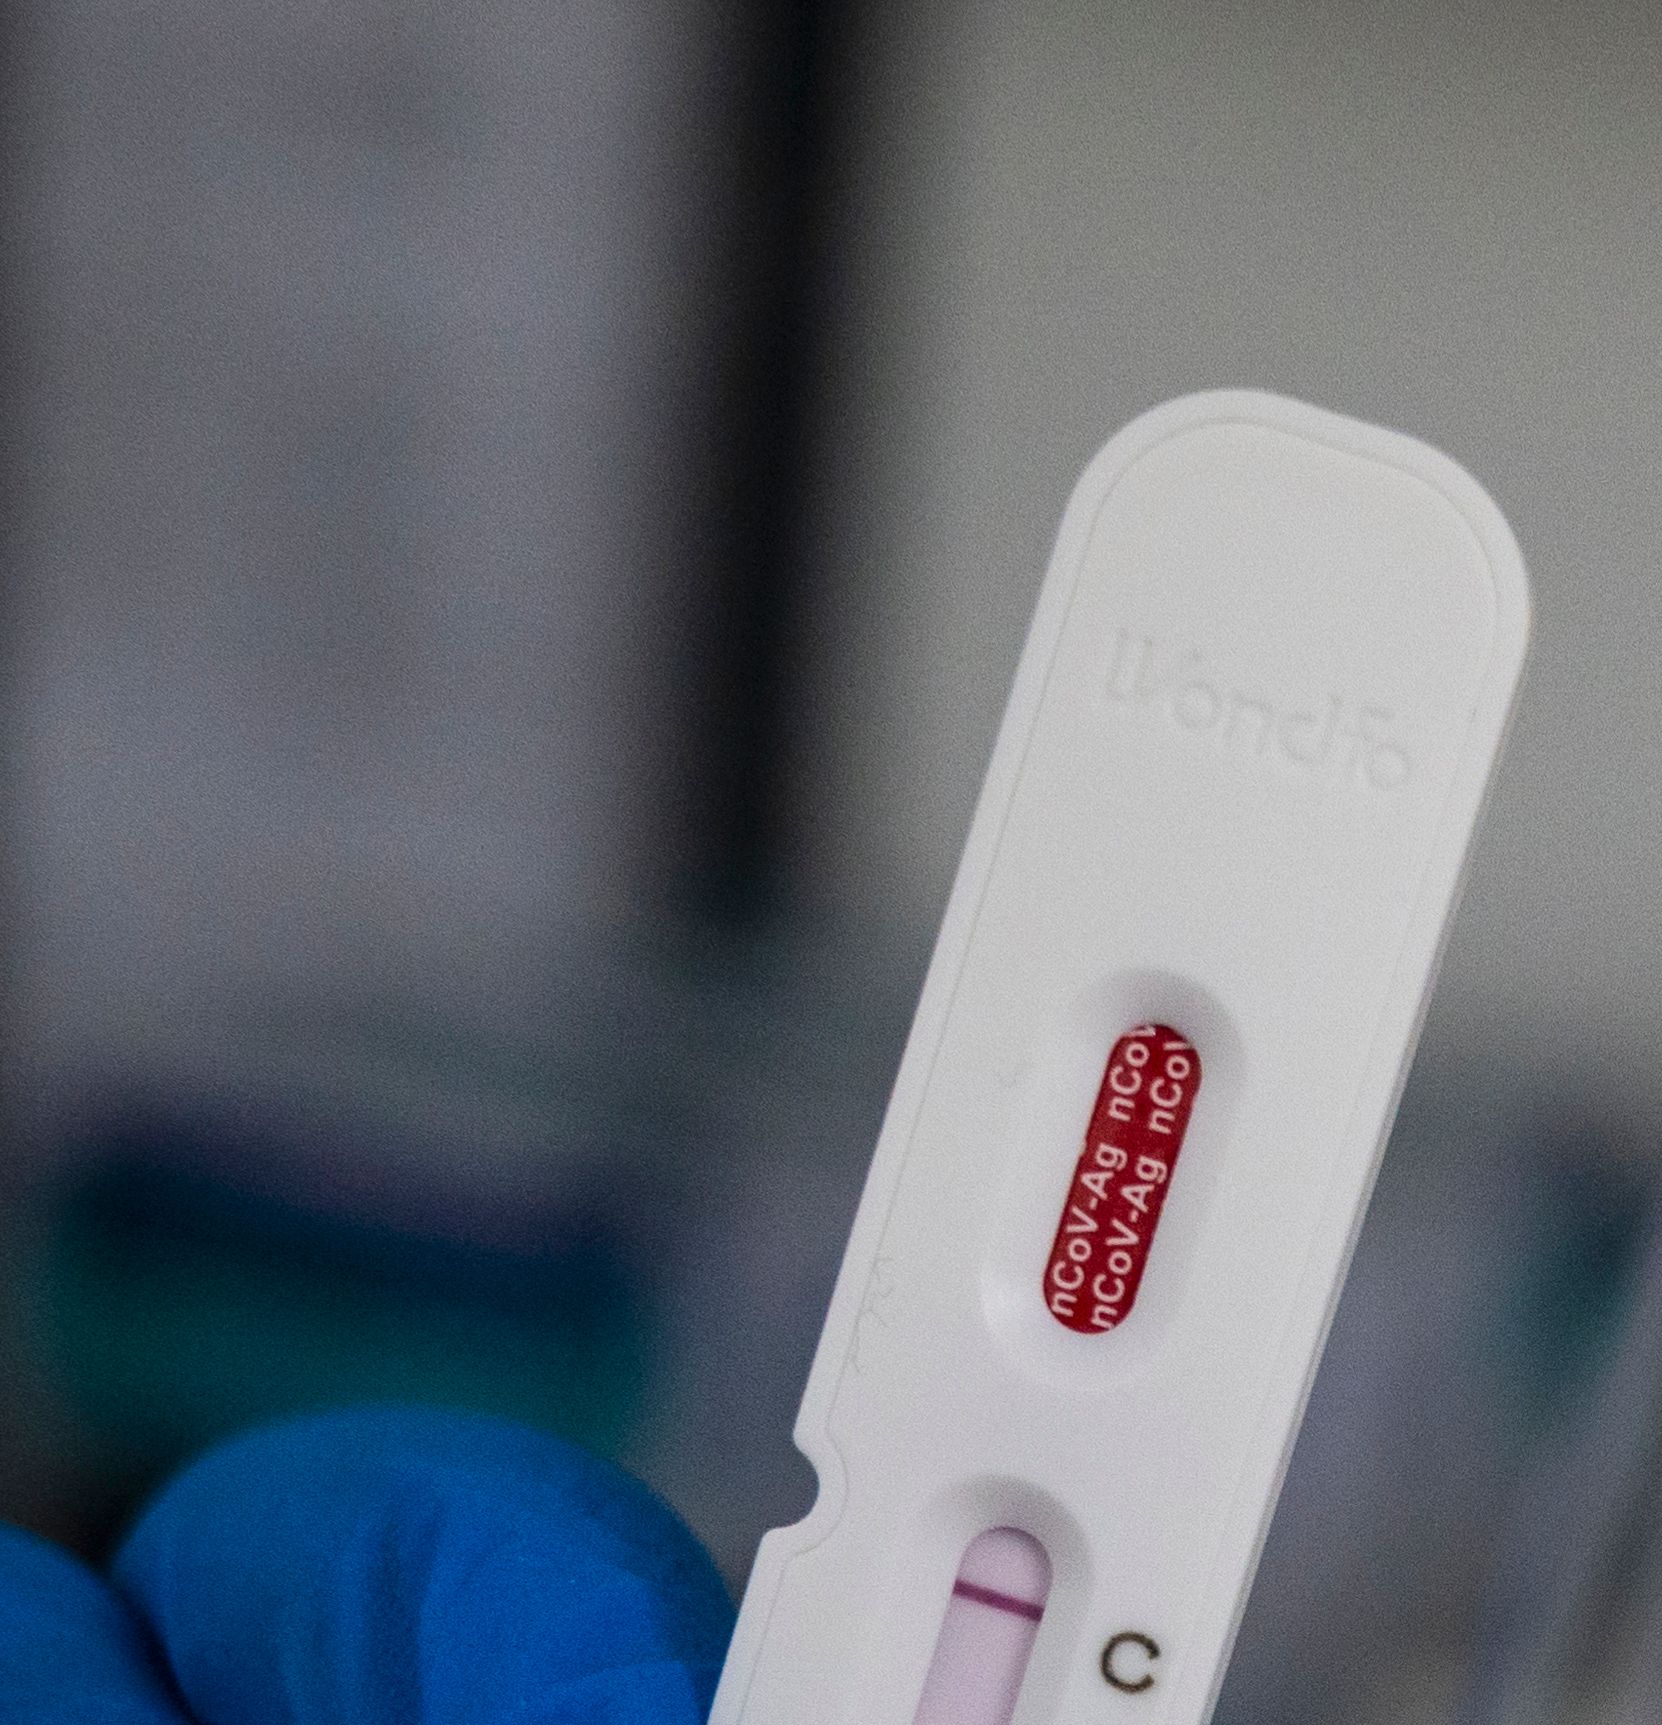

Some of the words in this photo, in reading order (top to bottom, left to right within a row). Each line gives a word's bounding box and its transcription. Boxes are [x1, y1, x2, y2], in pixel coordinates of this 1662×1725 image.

[1051, 1143, 1127, 1316] nCoV-Ag
[1091, 1155, 1168, 1330] nCoV-Ag
[1101, 1630, 1161, 1694] C
